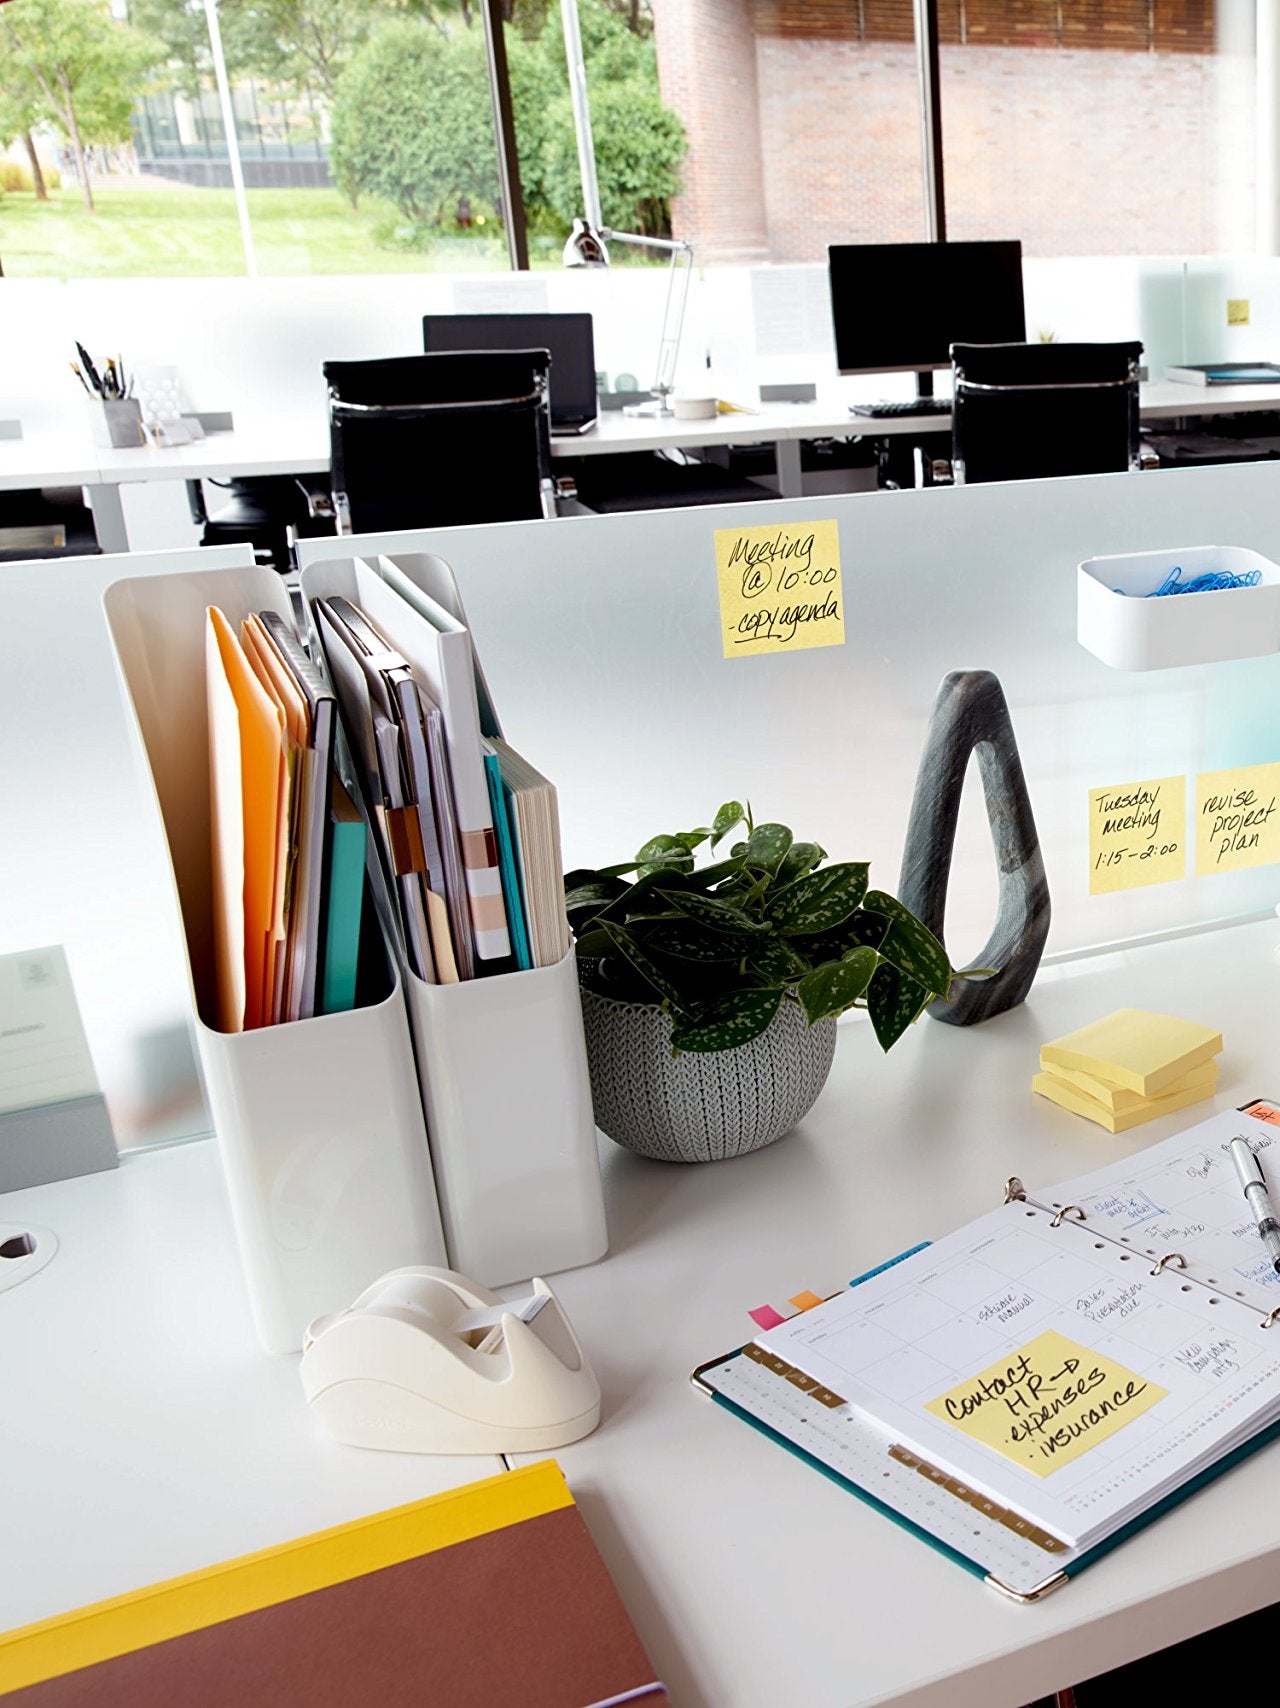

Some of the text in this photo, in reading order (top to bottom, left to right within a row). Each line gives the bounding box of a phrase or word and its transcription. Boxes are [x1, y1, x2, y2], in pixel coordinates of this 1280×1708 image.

[728, 531, 815, 573] Meeting
[776, 566, 837, 592] 10:00
[779, 590, 840, 642] agenda
[1096, 786, 1161, 813] Tuesday
[1202, 788, 1258, 815] revise
[1210, 797, 1277, 842] project
[1217, 832, 1259, 864] plan
[1076, 1287, 1105, 1312] Sales
[1120, 1298, 1142, 1318] due
[1174, 1342, 1202, 1365] New
[1004, 1374, 1057, 1416] HR
[1011, 1366, 1106, 1442] expenses
[1032, 1380, 1148, 1459] insurance
